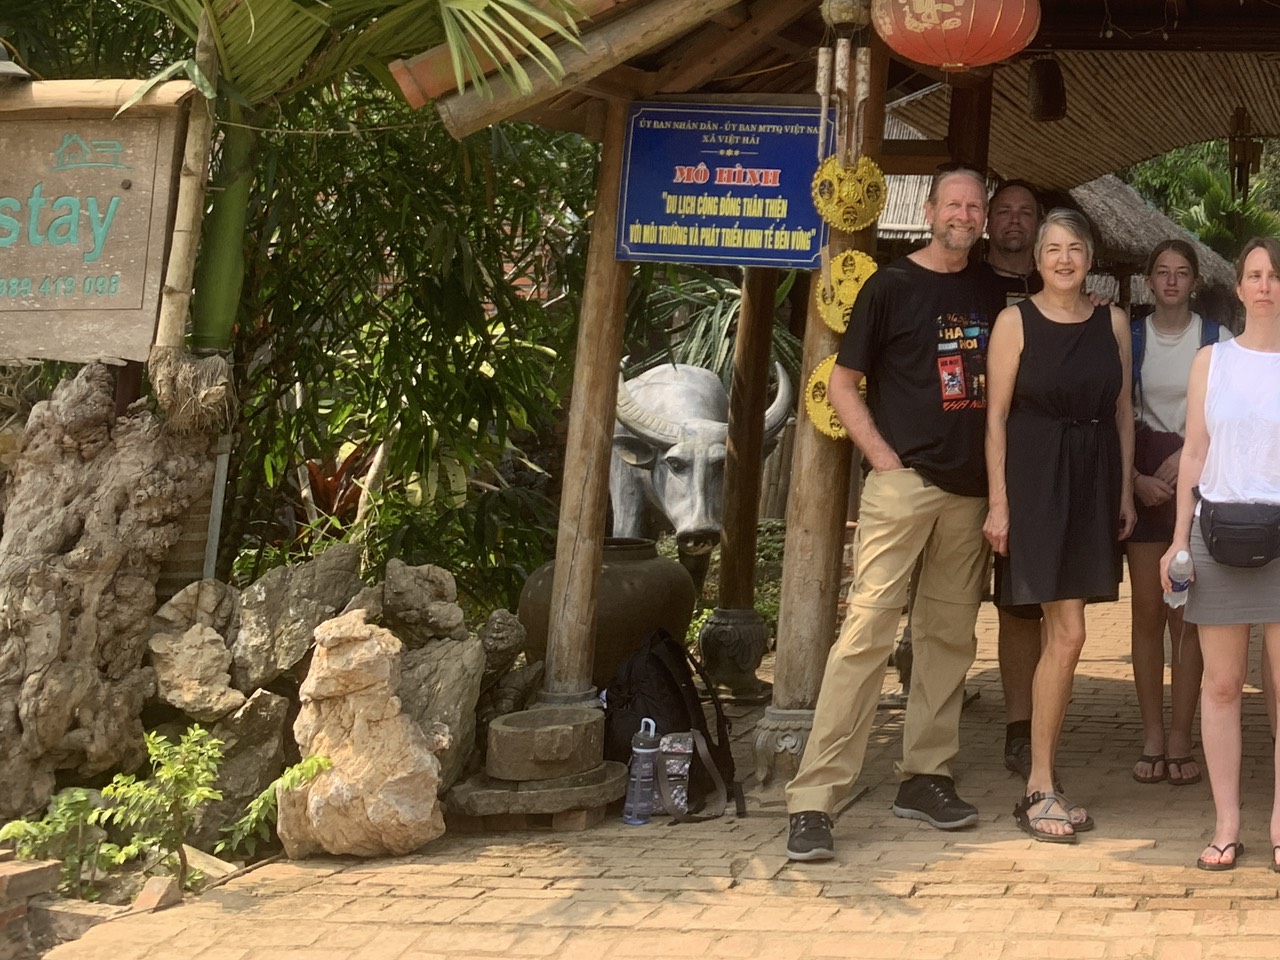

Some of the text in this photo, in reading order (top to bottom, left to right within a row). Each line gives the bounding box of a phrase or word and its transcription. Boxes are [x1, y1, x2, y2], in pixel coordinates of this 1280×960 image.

[653, 120, 672, 129] BAN
[739, 124, 757, 132] BAN
[758, 124, 783, 134] MTTQ
[807, 126, 821, 134] NA
[673, 162, 782, 186] MÔ HÌNH
[678, 195, 696, 218] LỊCH
[744, 229, 763, 248] KINH
[38, 276, 76, 296] 419
[82, 274, 120, 297] 098
[944, 326, 964, 340] HA
